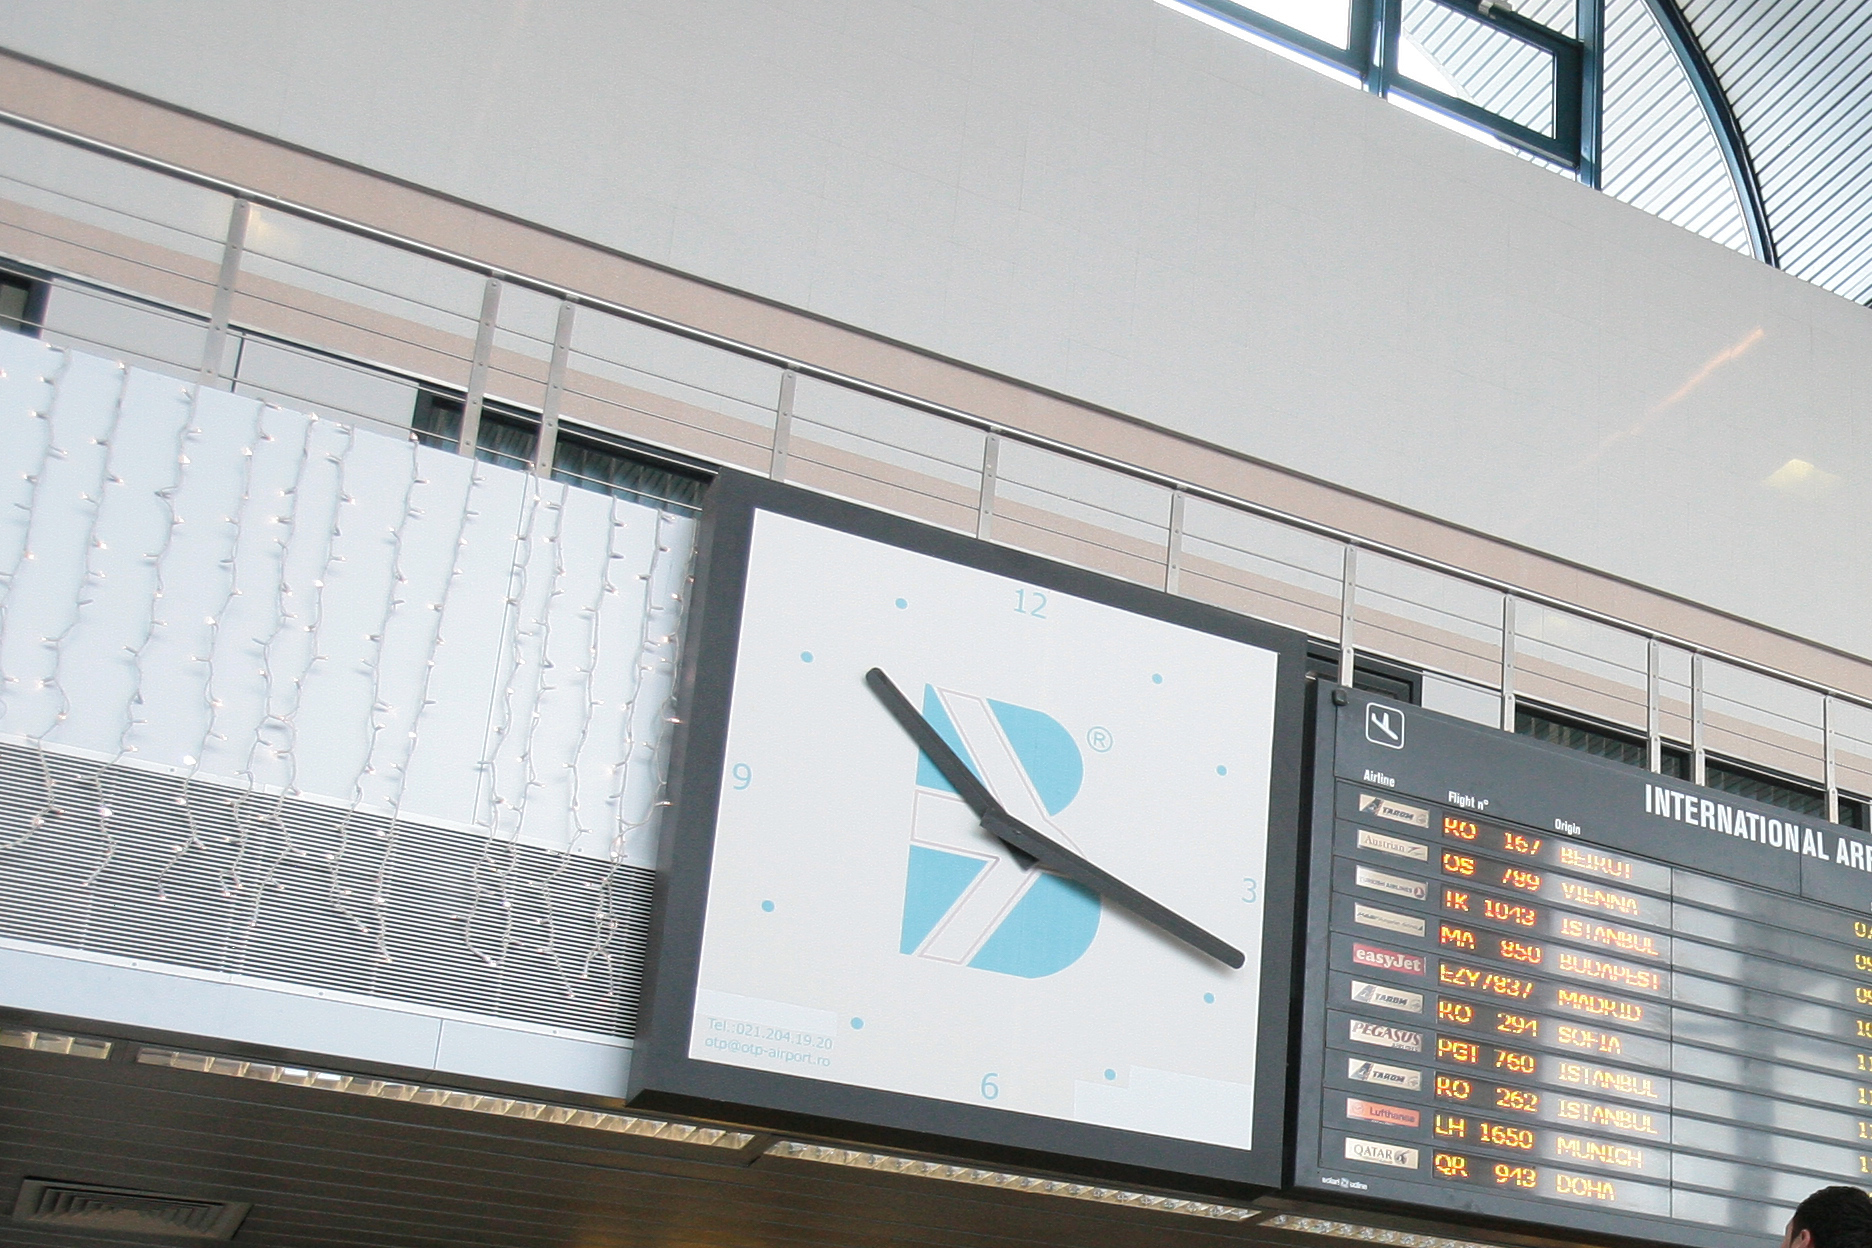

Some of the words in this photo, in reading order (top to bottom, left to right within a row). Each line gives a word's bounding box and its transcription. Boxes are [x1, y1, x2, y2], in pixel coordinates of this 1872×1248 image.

[1013, 588, 1048, 619] 12
[731, 762, 753, 791] 9
[1363, 769, 1396, 788] Airline
[1448, 790, 1476, 809] Flight
[1444, 817, 1478, 840] RO
[1554, 818, 1581, 836] Origin
[1645, 783, 1830, 861] INTERNATIONAL
[1364, 834, 1404, 852] Austrian
[1443, 853, 1476, 876] OS
[1242, 877, 1258, 904] 3
[1440, 925, 1476, 950] MA
[1356, 948, 1422, 972] easyJet
[1375, 992, 1408, 1005] TAROM
[1557, 988, 1643, 1023] MADRID
[1352, 1021, 1420, 1046] PEGASUS
[1438, 1000, 1474, 1024] RO
[1557, 1025, 1622, 1055] SOFIA
[704, 1037, 831, 1067] otp@otp-airport.ro
[980, 1072, 999, 1100] 6
[1372, 1070, 1405, 1083] TAROM
[1558, 1060, 1658, 1098] ISTANBUL
[1369, 1106, 1416, 1123] Lufthansa
[1436, 1075, 1473, 1100] RO
[1557, 1098, 1658, 1135] ISTANBUL
[1353, 1143, 1393, 1160] QATAR
[1434, 1113, 1466, 1139] LH
[1479, 1121, 1535, 1150] 1650
[1556, 1136, 1643, 1169] MUNICH
[1433, 1152, 1469, 1178] QR
[1556, 1173, 1617, 1201] DOHA
